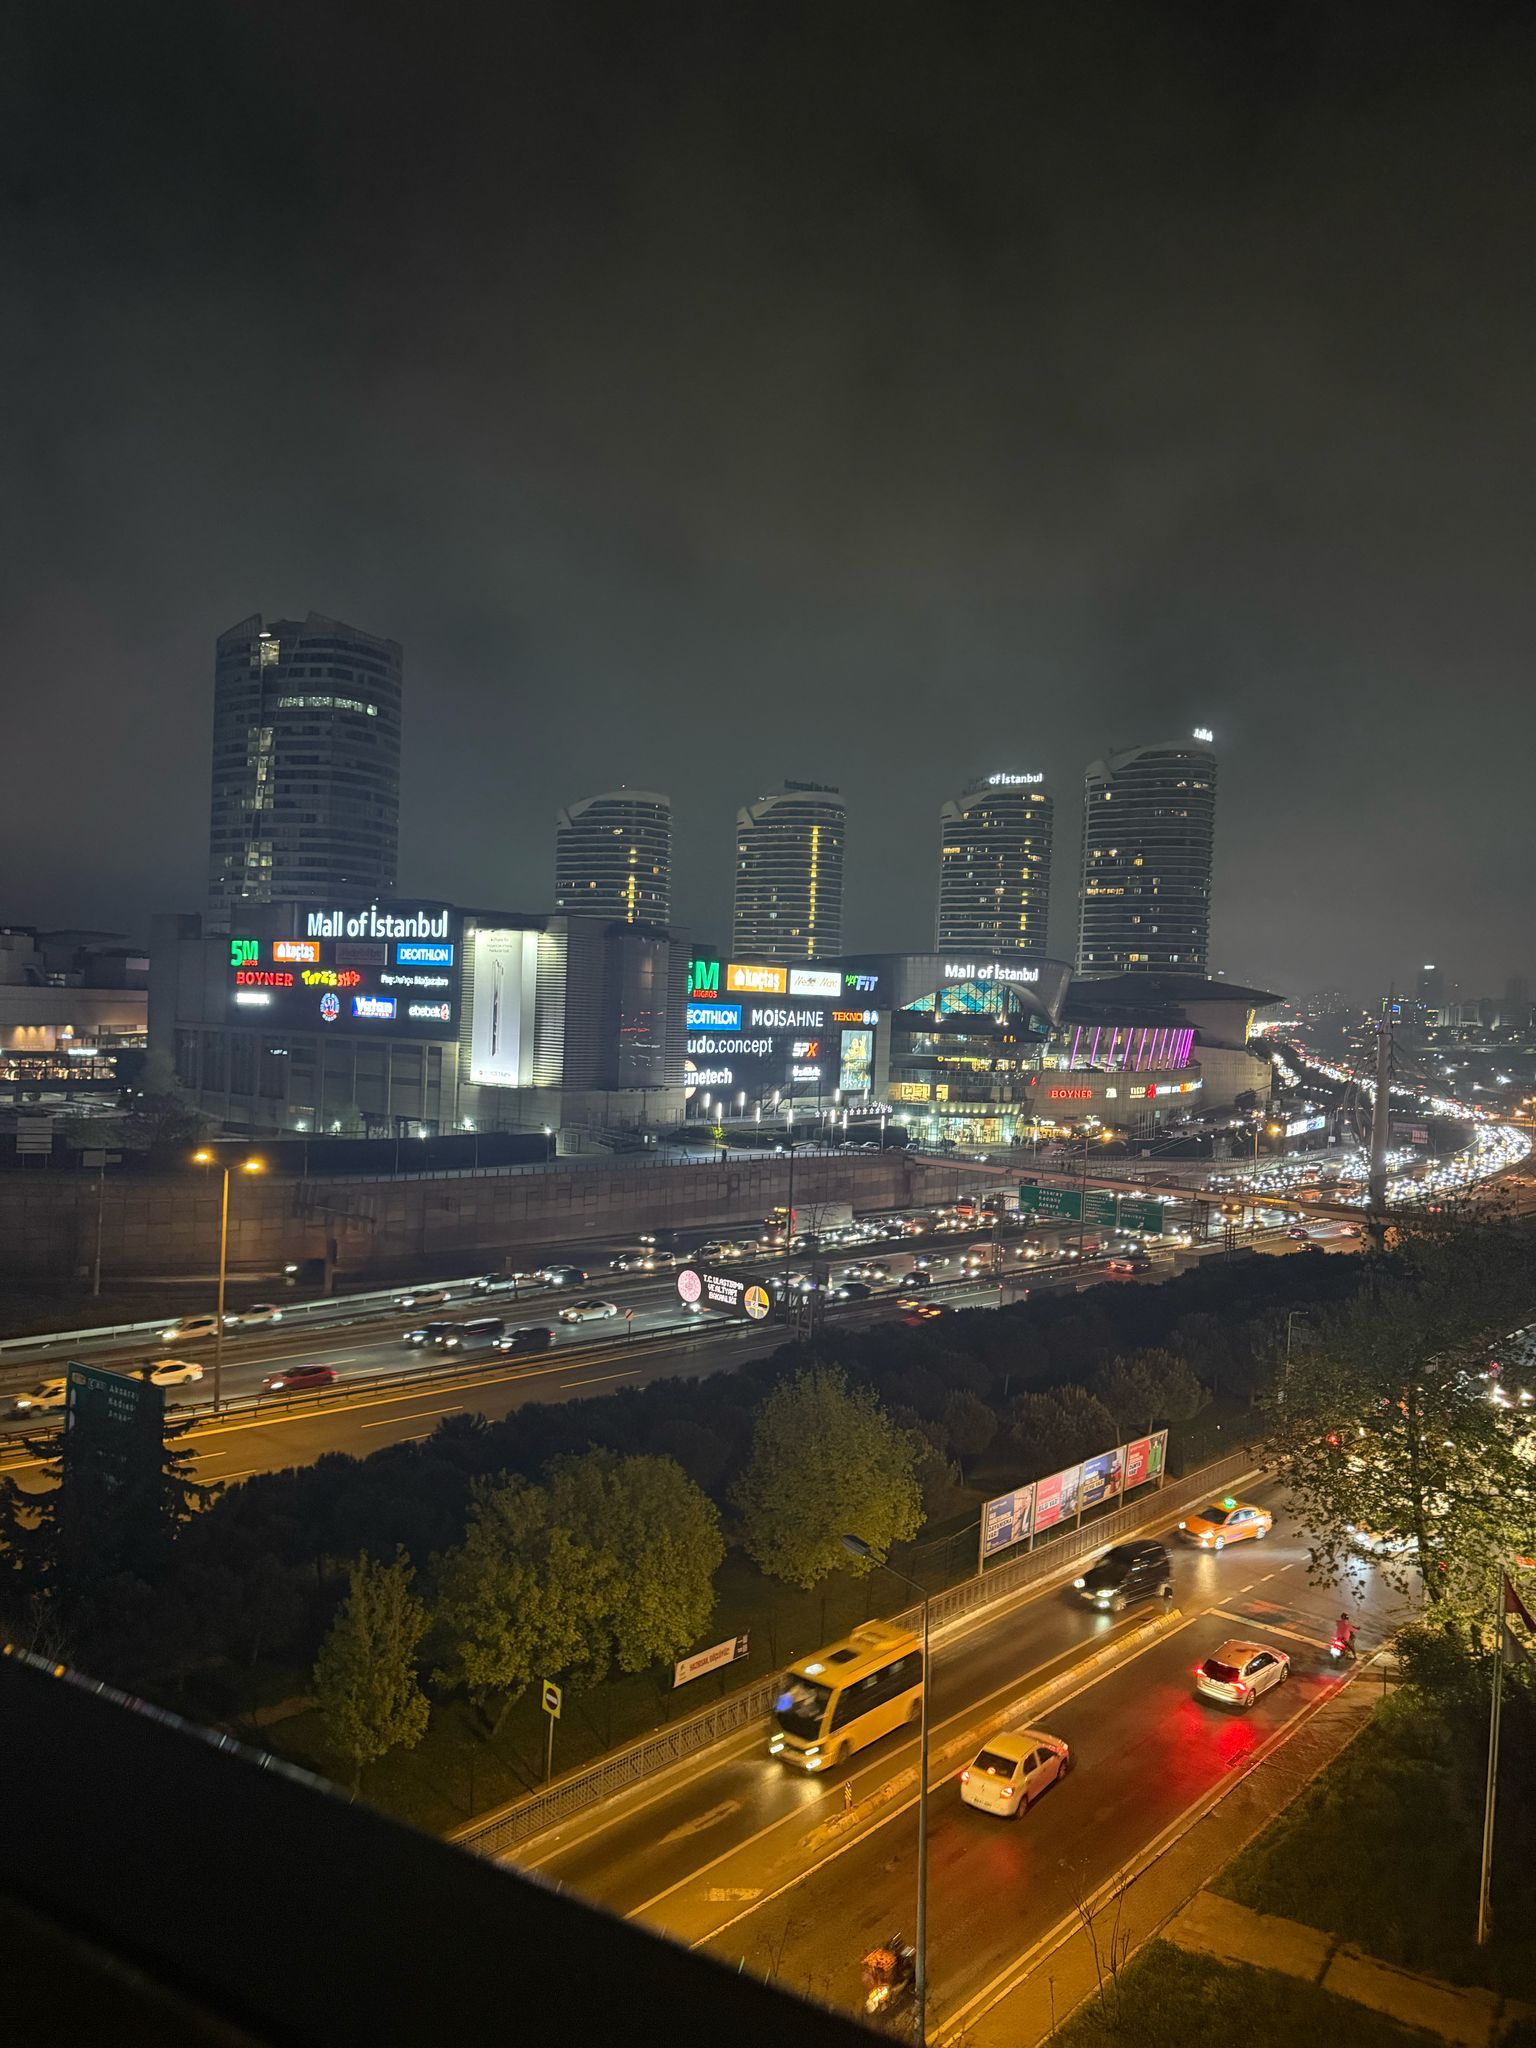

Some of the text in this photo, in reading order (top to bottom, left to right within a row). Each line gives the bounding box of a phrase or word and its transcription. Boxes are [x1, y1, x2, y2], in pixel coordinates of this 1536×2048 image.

[307, 904, 449, 938] Mall of İstanbul
[230, 940, 259, 966] 5M
[400, 948, 449, 961] DECATHLON
[236, 971, 294, 987] BOYNER
[944, 964, 976, 979] Mall
[977, 965, 994, 979] of
[408, 1004, 441, 1018] ebebek
[832, 1009, 880, 1026] TEKNOSA
[792, 1042, 819, 1058] SPX
[1051, 1089, 1092, 1099] BOYNER
